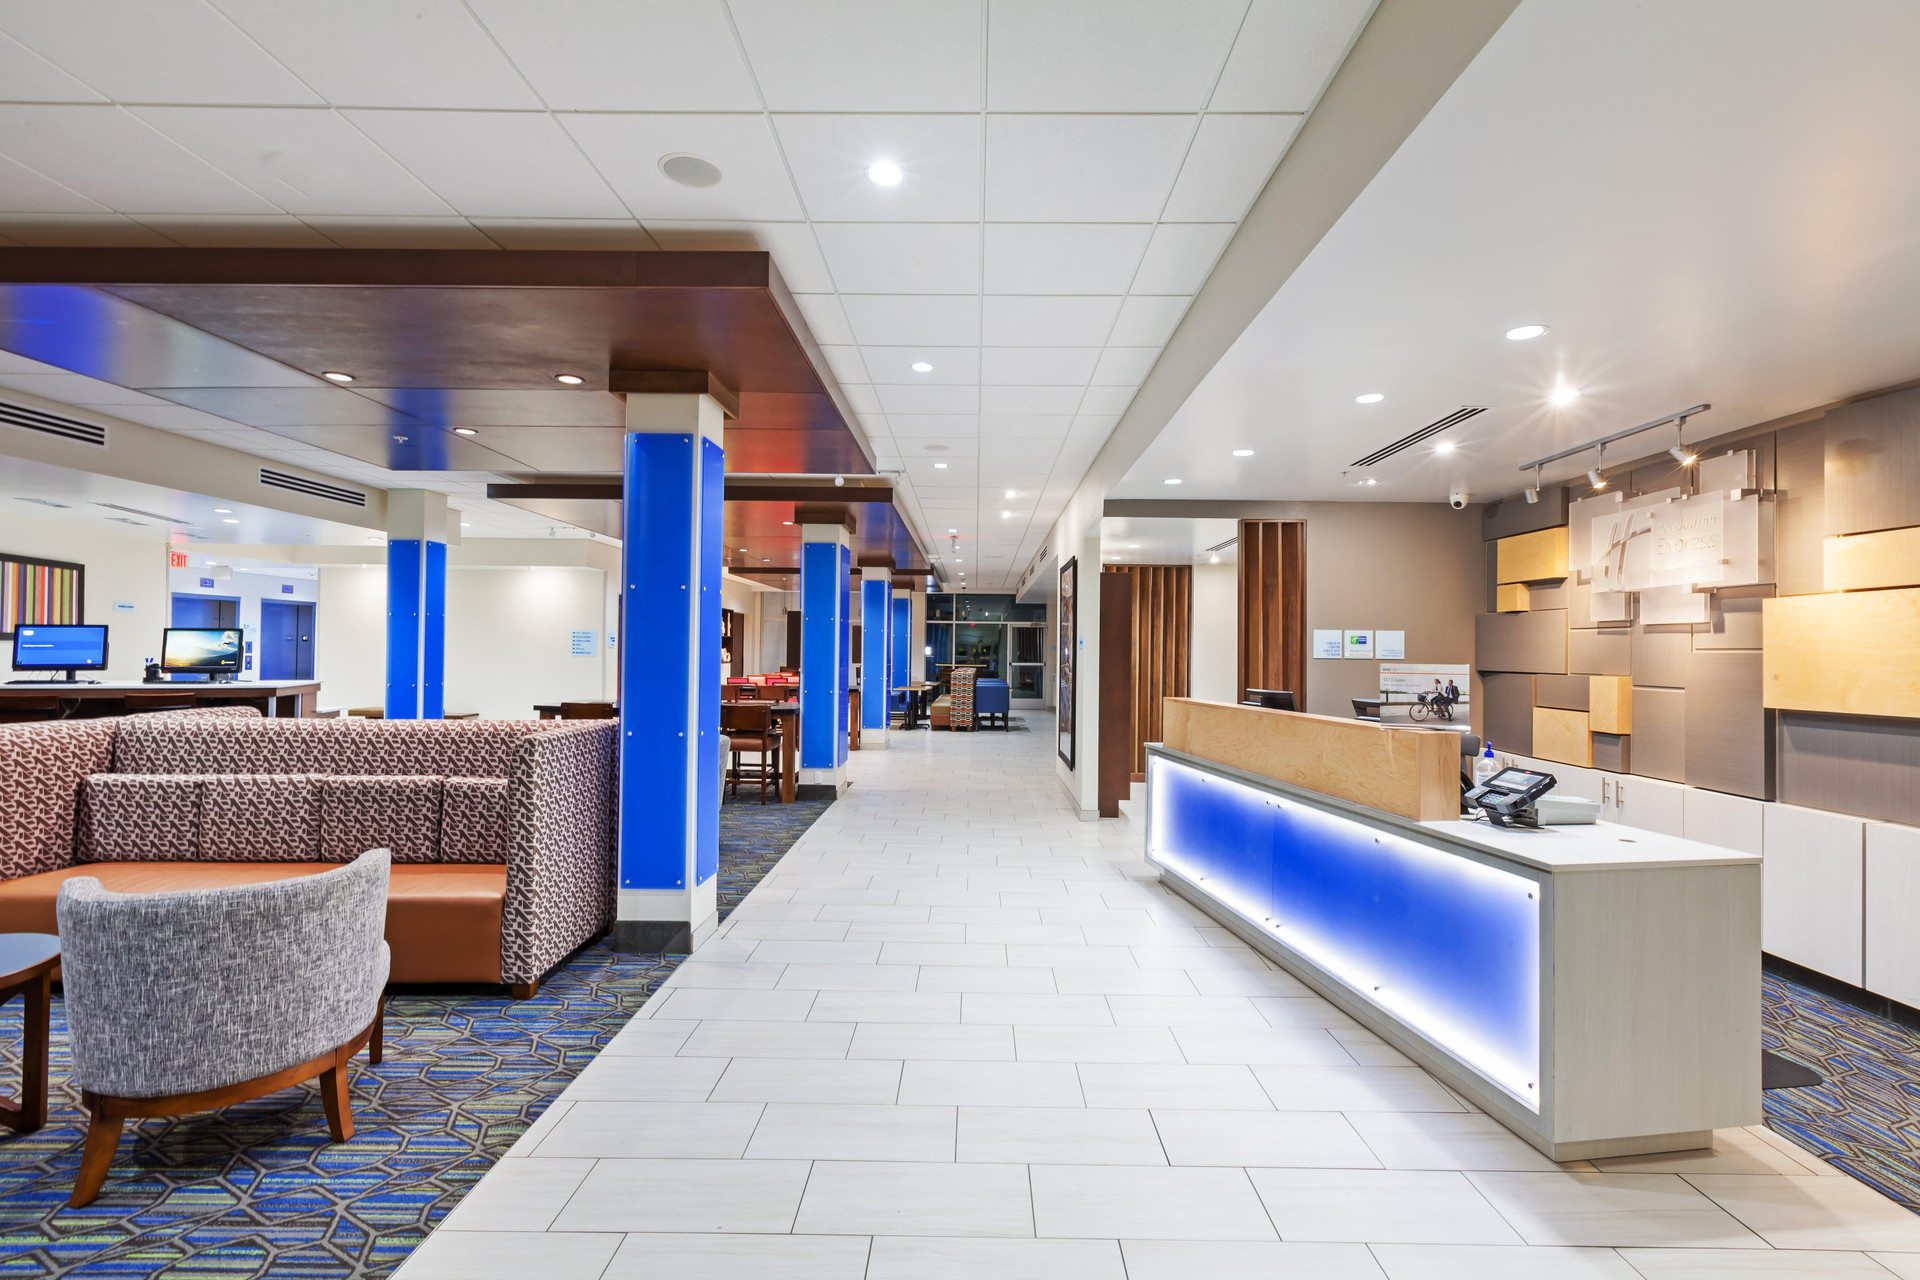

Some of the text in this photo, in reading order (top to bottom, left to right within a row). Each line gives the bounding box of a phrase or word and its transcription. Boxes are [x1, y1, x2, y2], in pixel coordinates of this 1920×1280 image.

[1700, 513, 1718, 529] Inn
[1656, 534, 1717, 555] Express
[171, 553, 187, 568] EXIT
